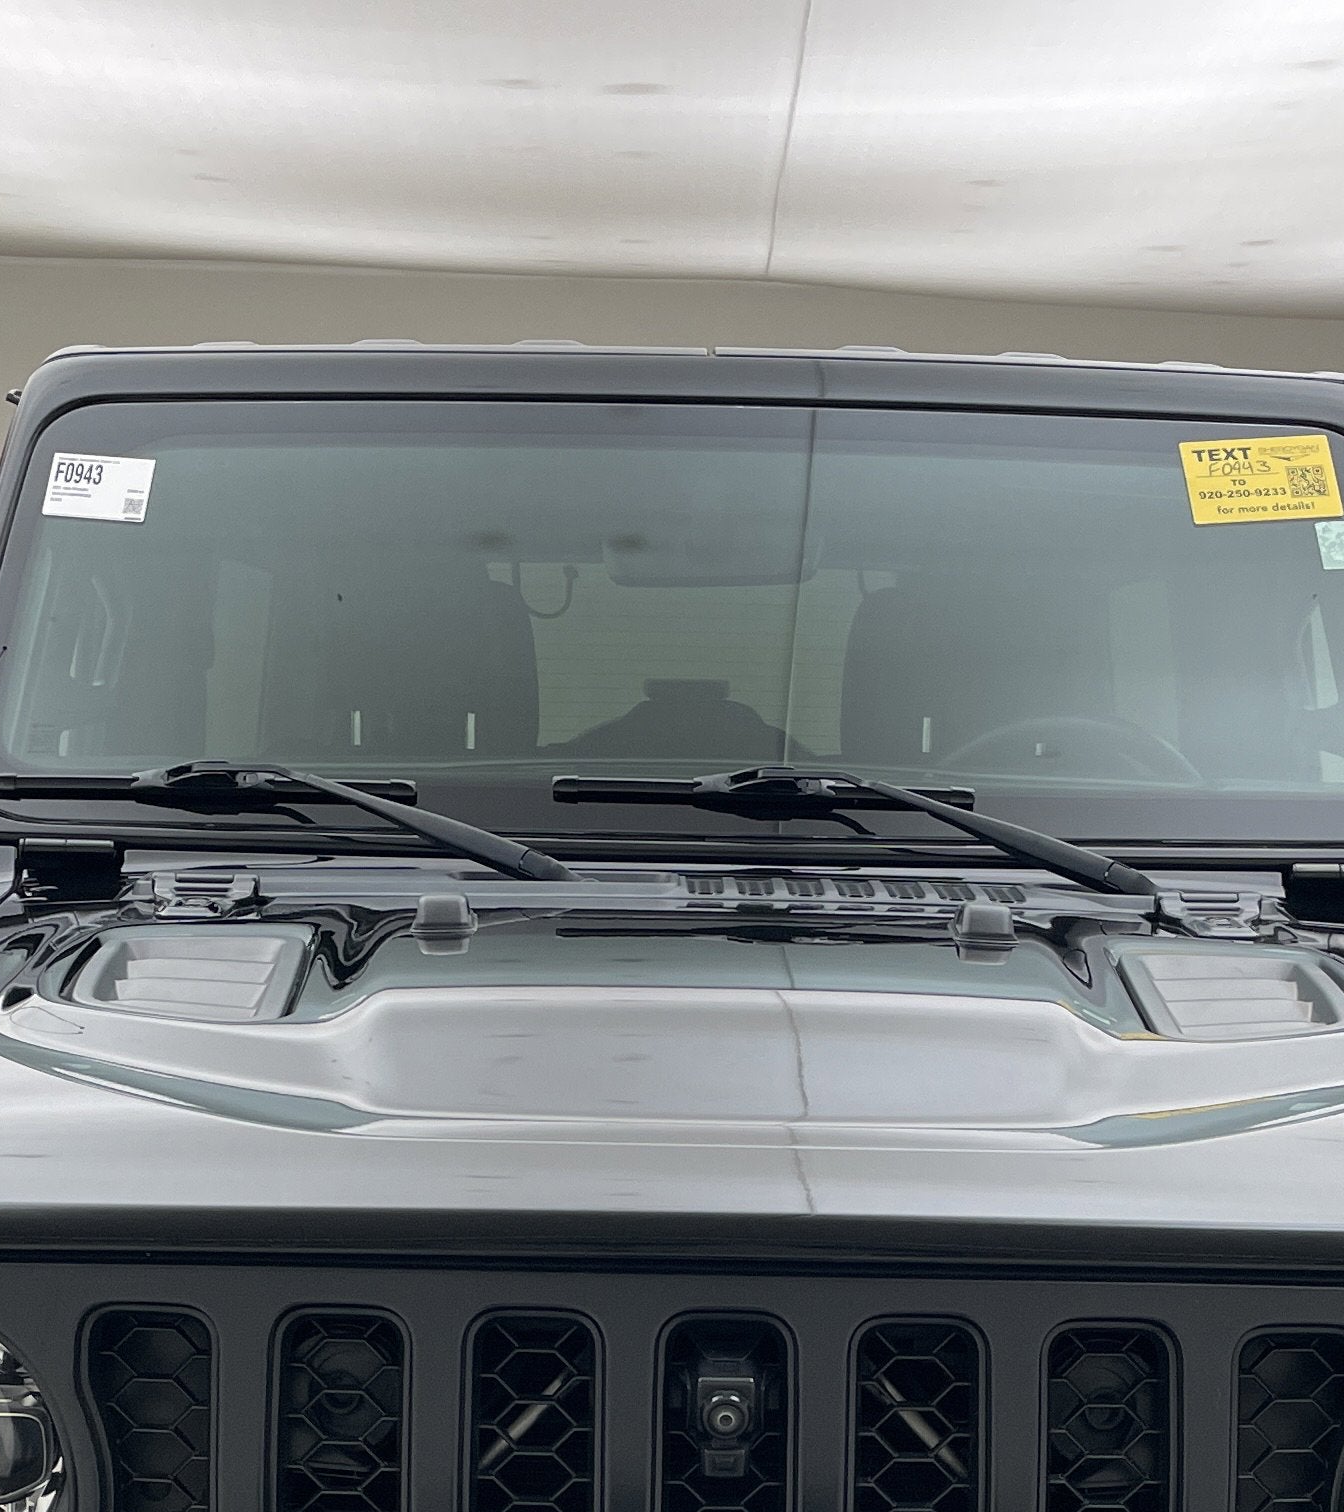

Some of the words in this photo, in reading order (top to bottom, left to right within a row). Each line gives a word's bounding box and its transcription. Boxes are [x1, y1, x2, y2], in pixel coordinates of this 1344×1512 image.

[1191, 447, 1252, 462] TEXT
[54, 461, 104, 485] F0943
[1209, 460, 1272, 477] F0943
[1198, 487, 1287, 499] 920-250-9233
[1217, 505, 1234, 514] for
[1238, 505, 1268, 513] more
[1272, 501, 1315, 511] details!
